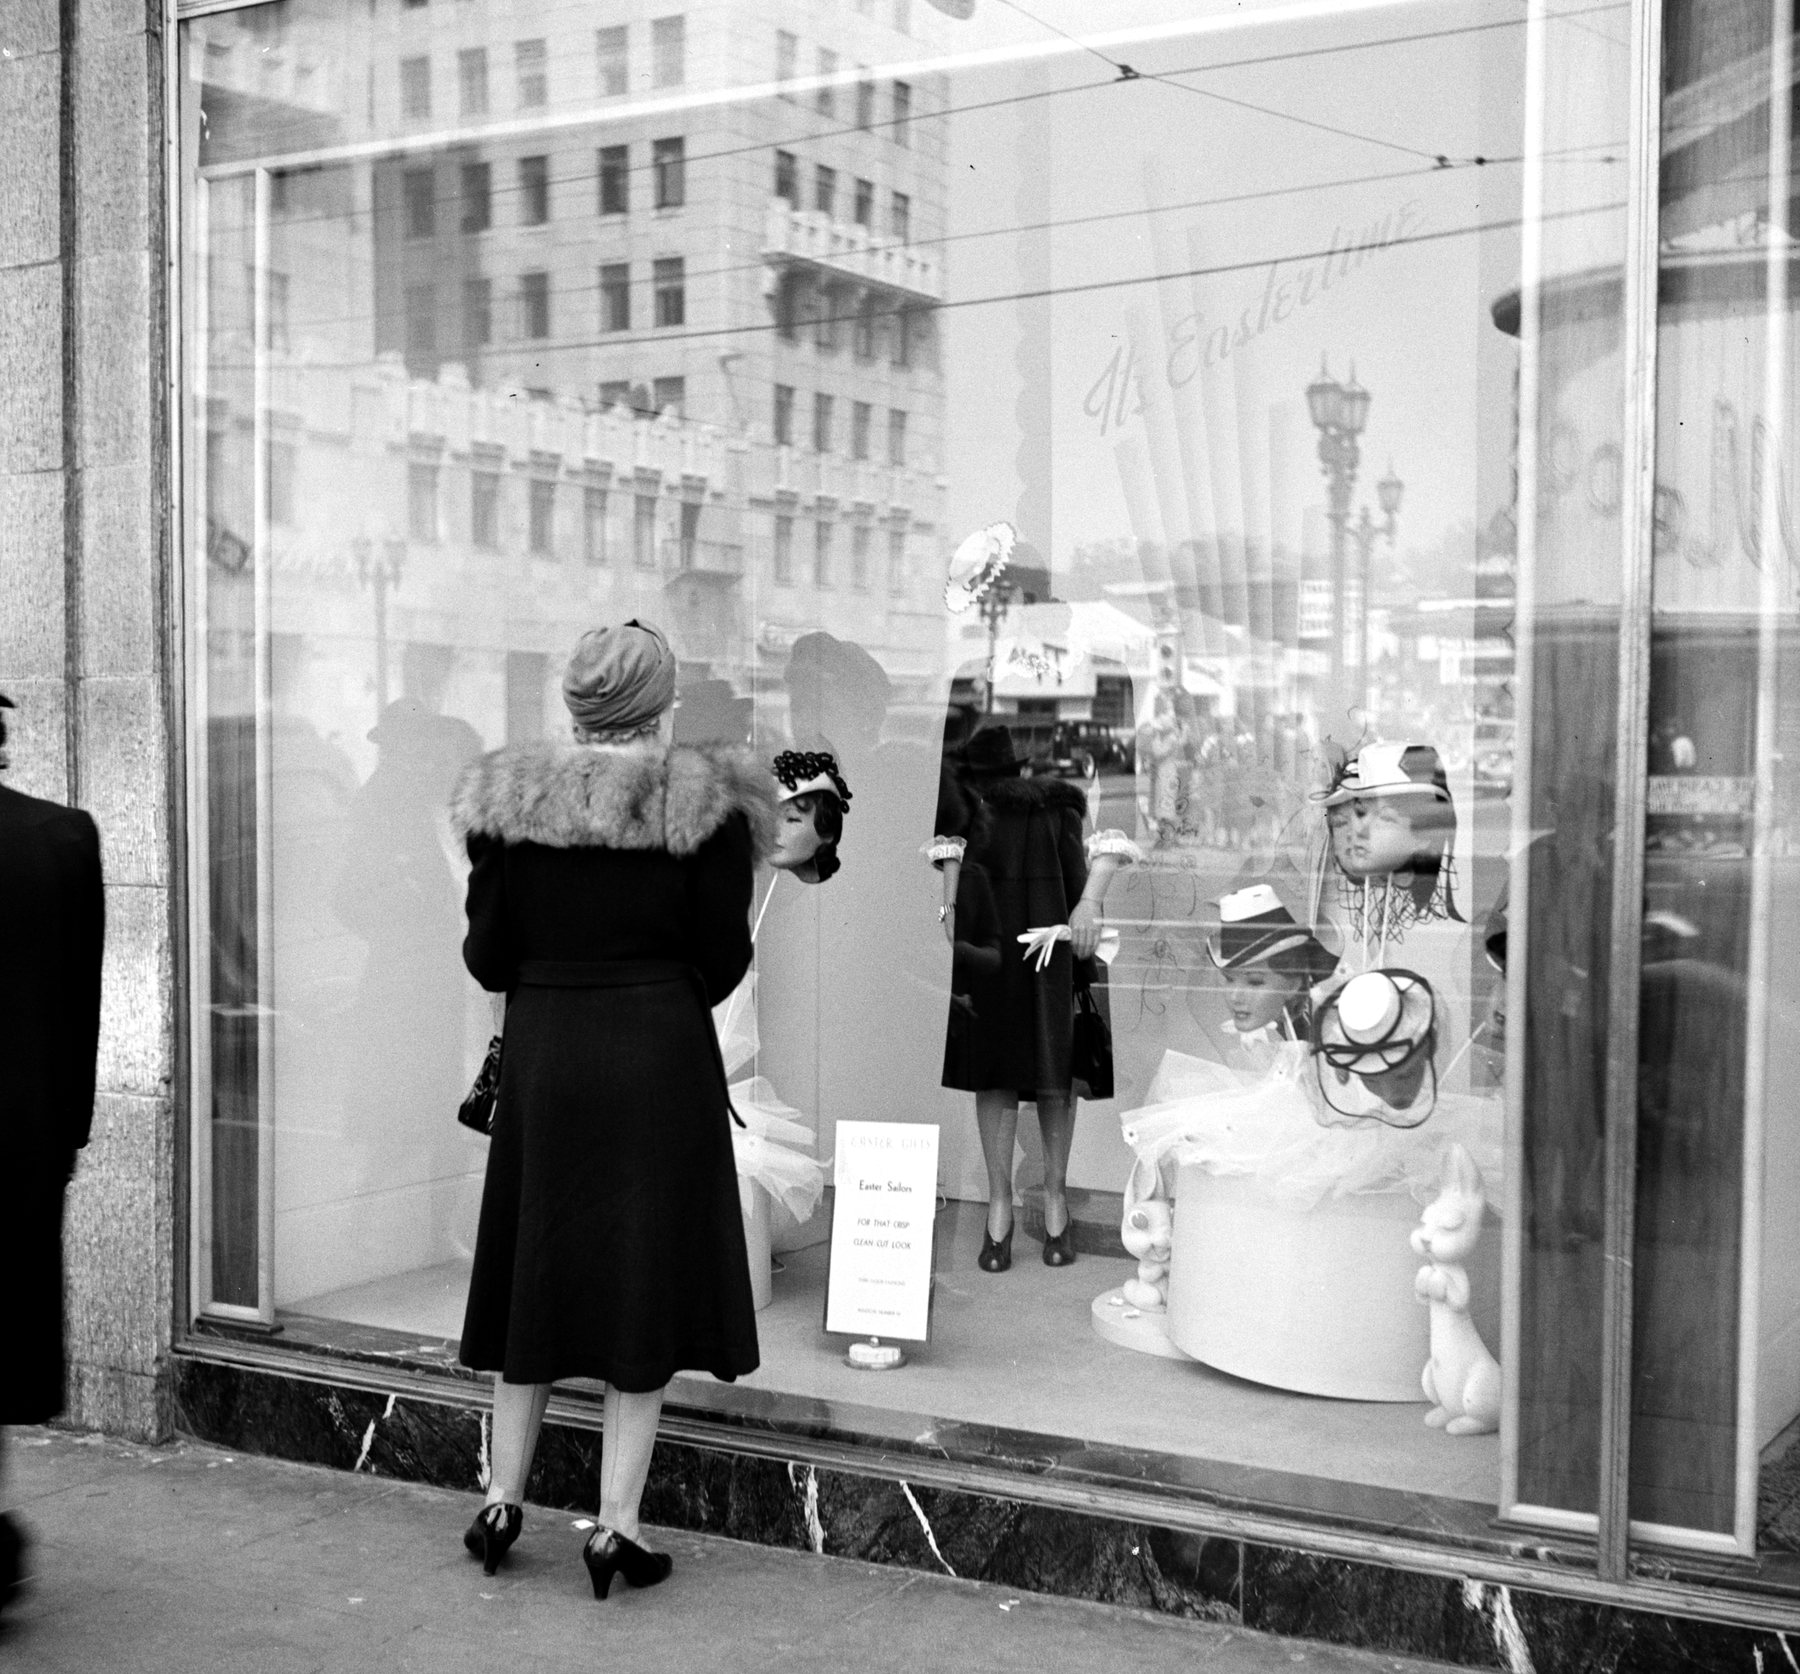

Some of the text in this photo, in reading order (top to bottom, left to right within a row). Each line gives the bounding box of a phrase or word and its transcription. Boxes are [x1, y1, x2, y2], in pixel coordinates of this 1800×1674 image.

[859, 1179, 913, 1193] Easter Sailors
[857, 1217, 911, 1230] FOR THAT CRISP
[853, 1238, 912, 1250] CLEAN CUT LOOK
